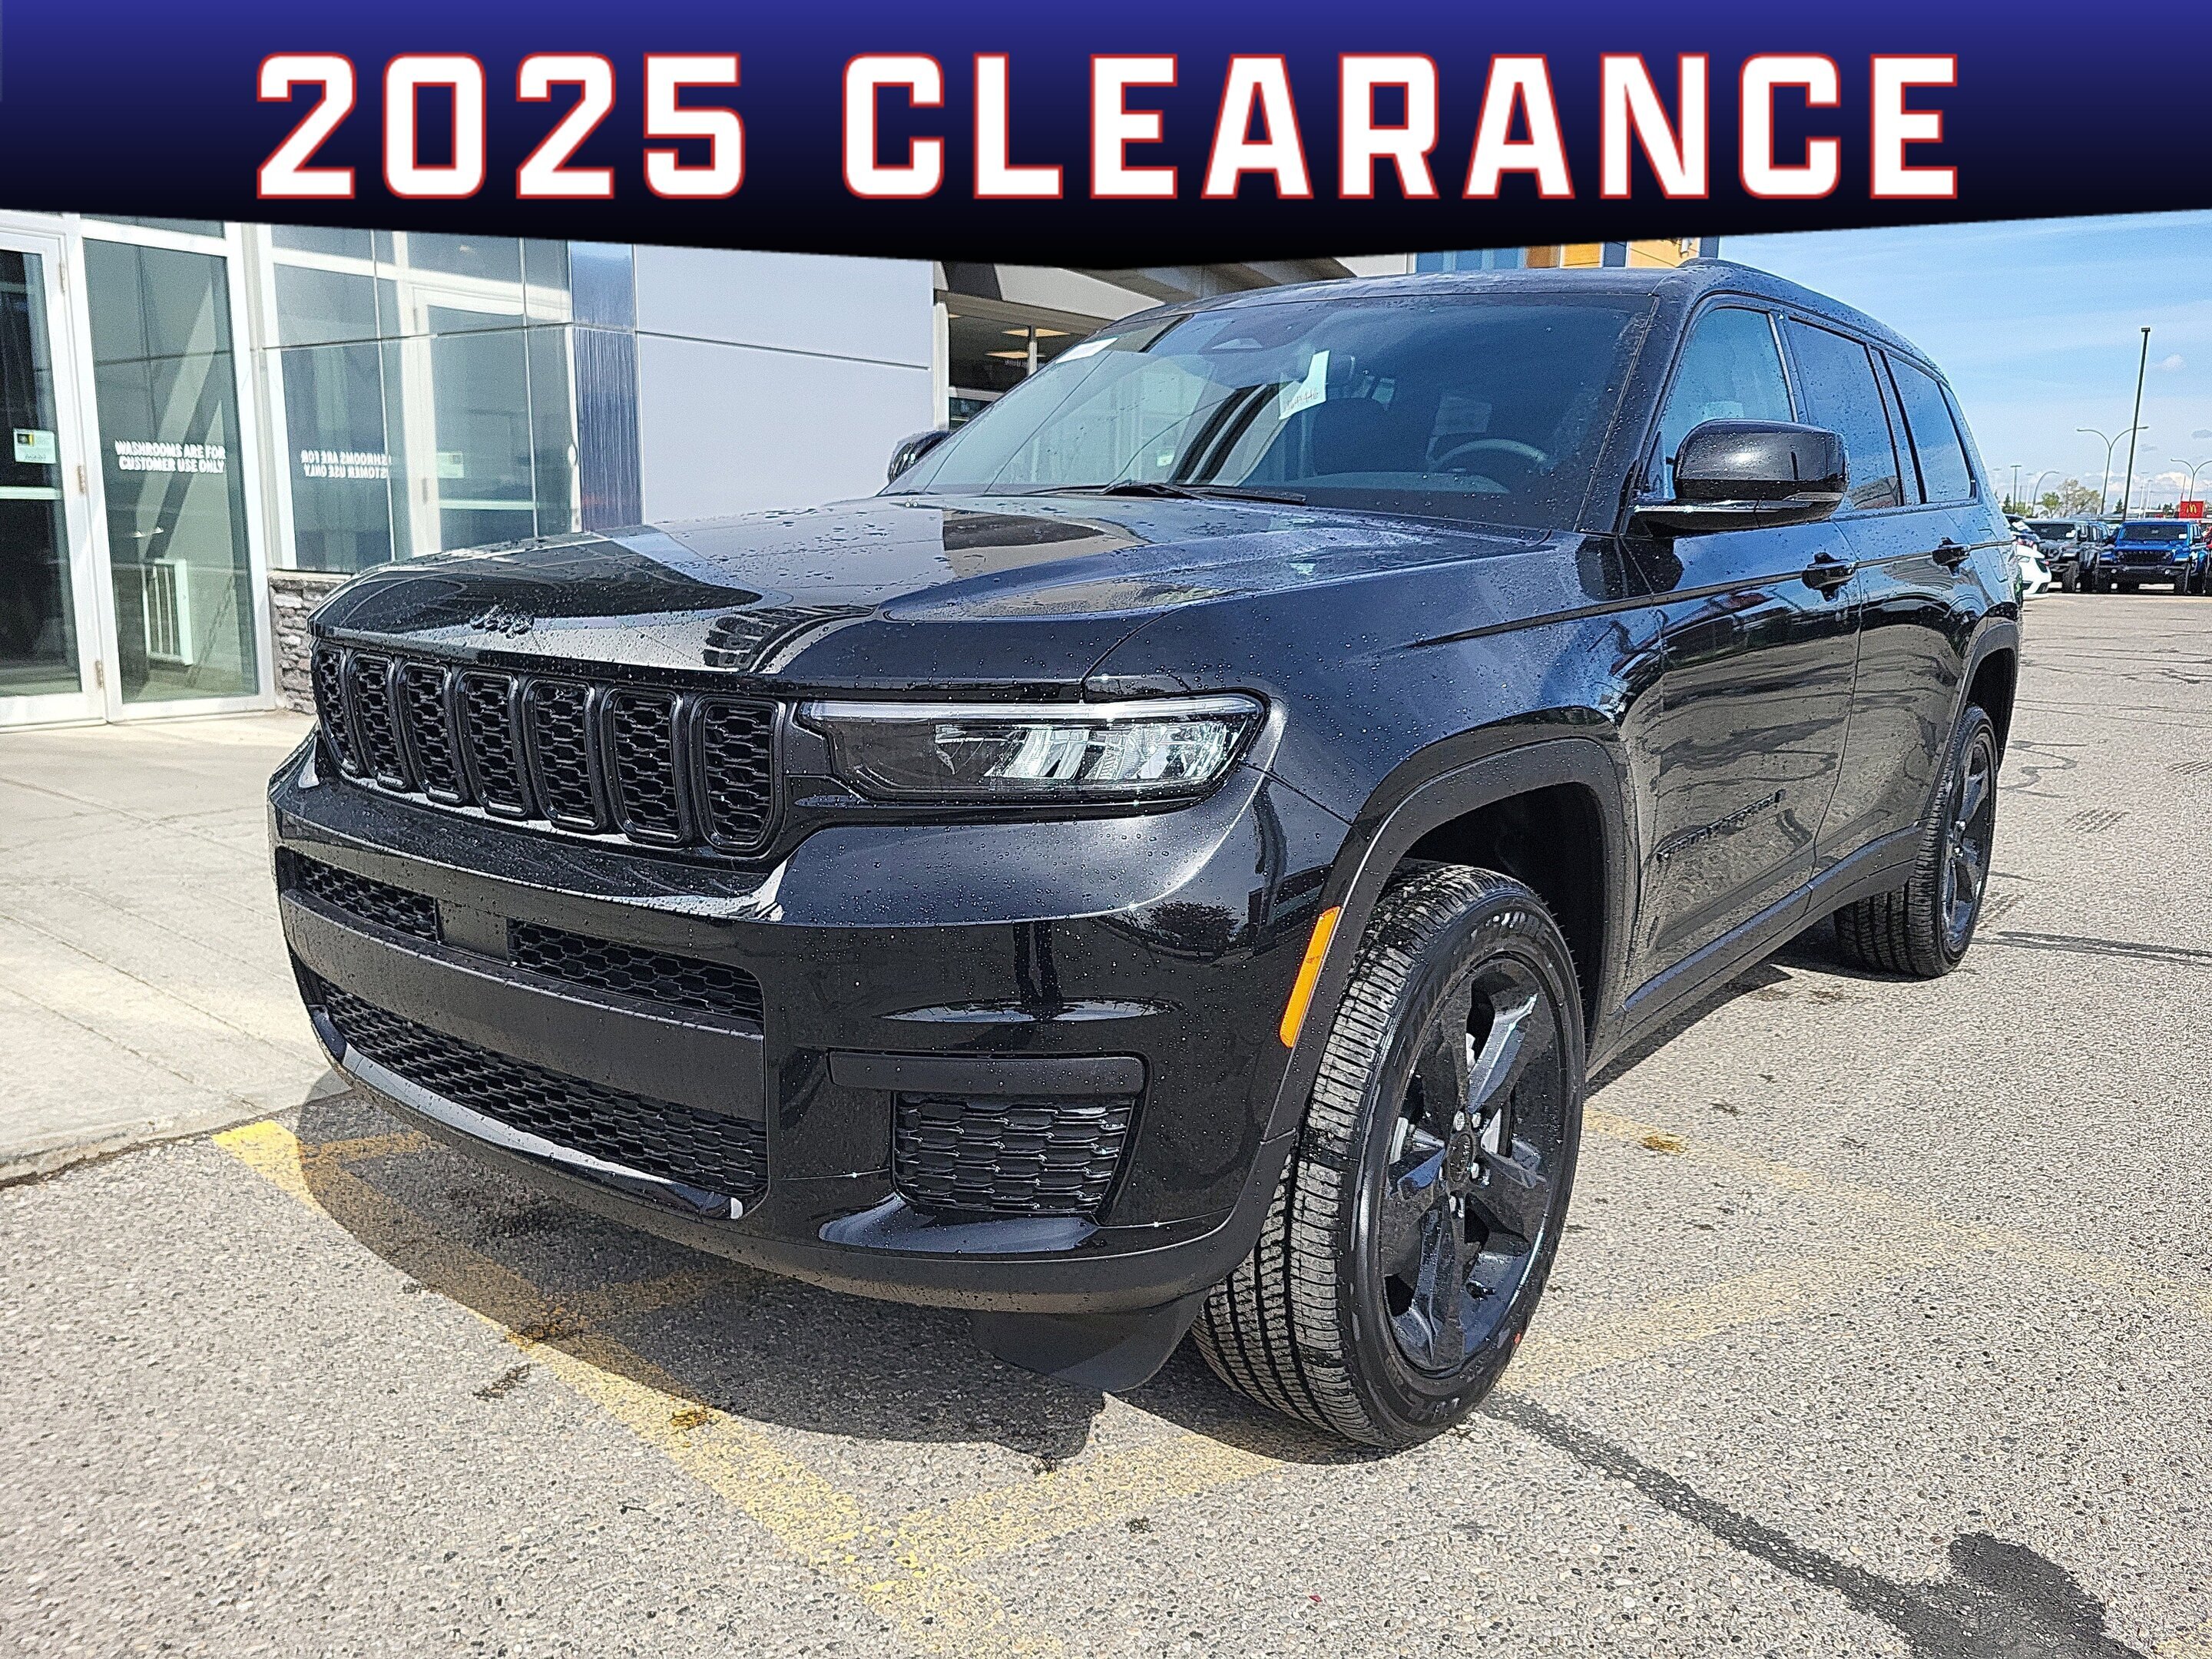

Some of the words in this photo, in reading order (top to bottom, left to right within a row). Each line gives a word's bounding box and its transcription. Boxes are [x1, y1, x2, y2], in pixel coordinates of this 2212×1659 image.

[115, 439, 183, 458] WASHROOMS
[184, 443, 204, 459] ARE
[205, 445, 226, 459] FOR
[119, 455, 176, 472] CUSTOMER
[177, 458, 198, 473] USE
[198, 459, 225, 473] ONLY
